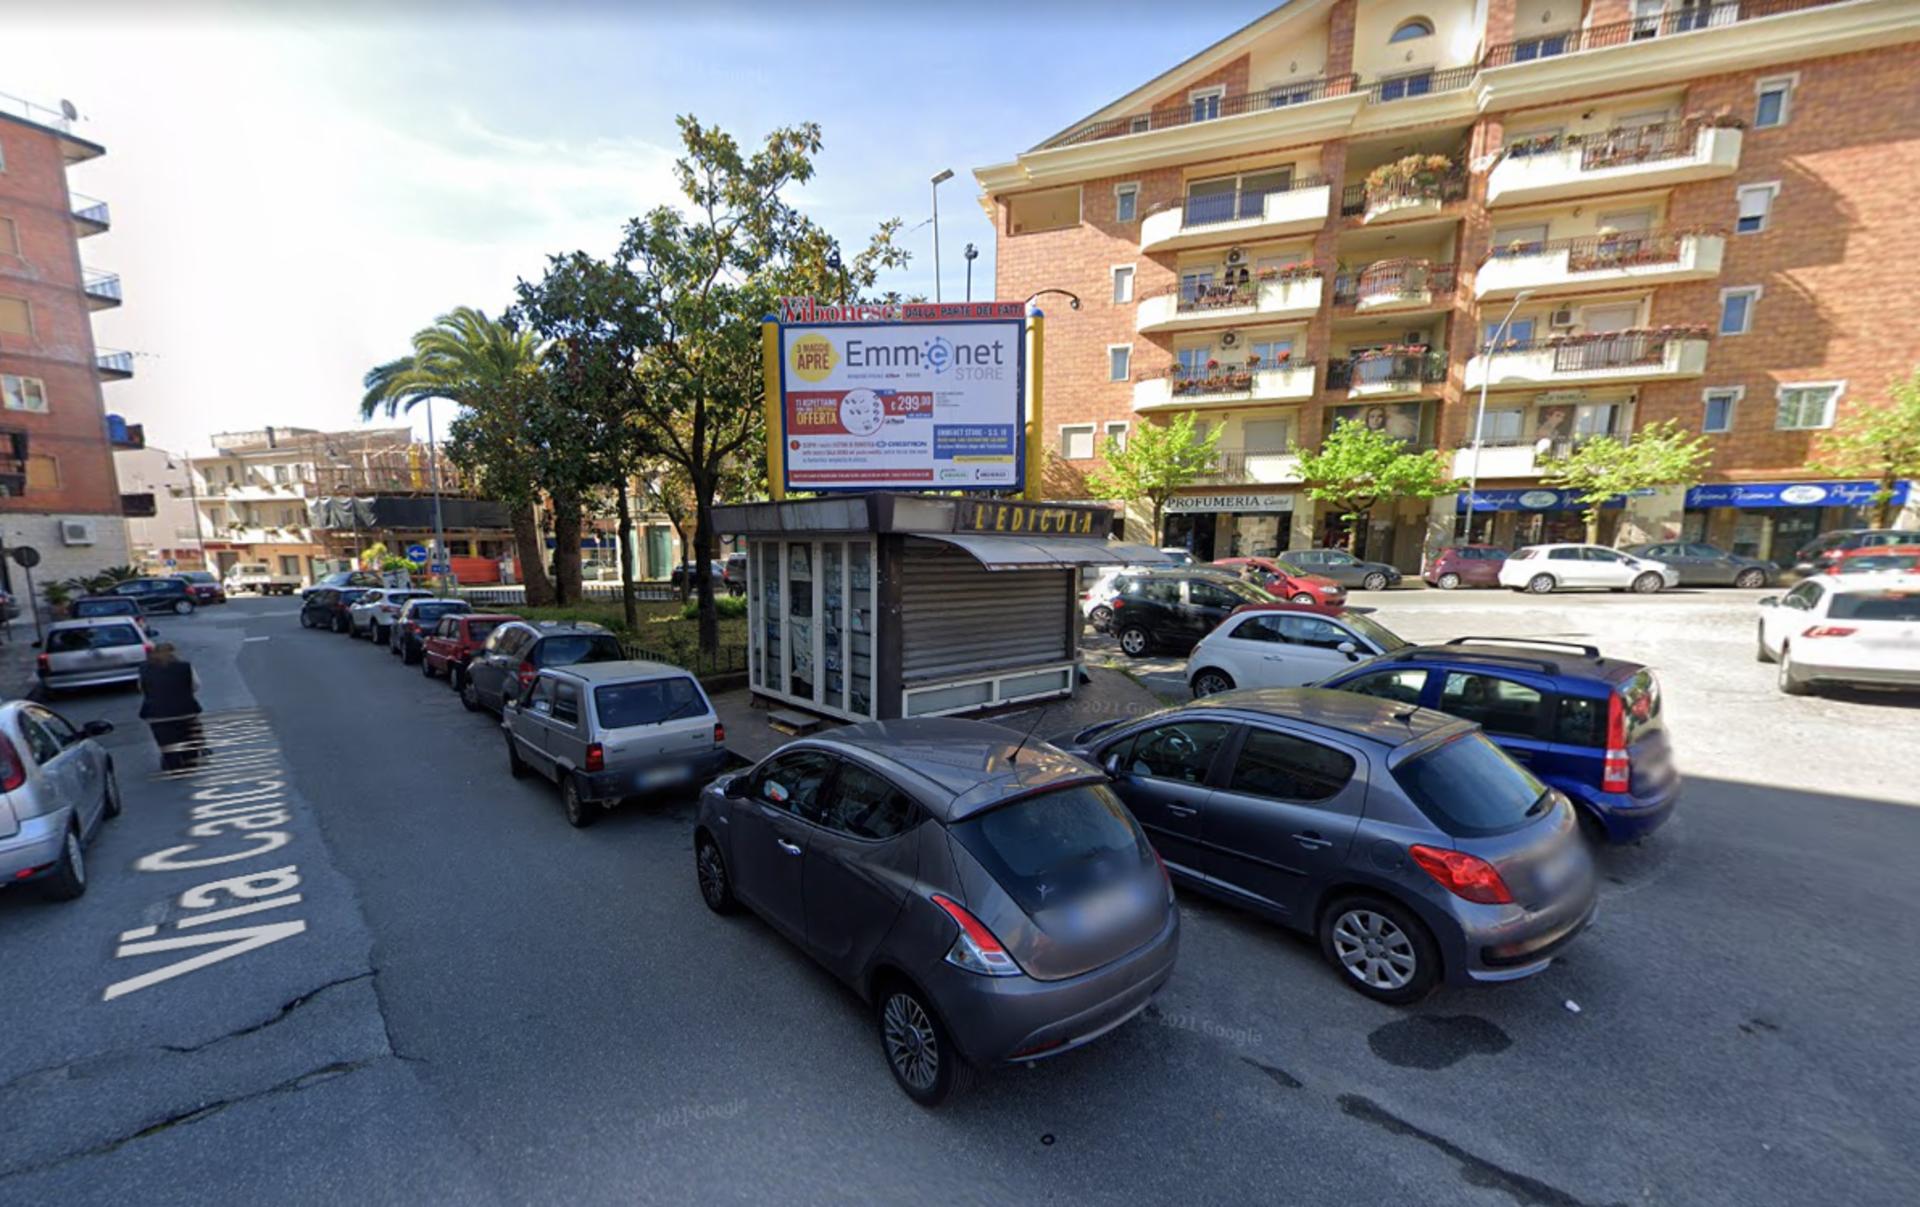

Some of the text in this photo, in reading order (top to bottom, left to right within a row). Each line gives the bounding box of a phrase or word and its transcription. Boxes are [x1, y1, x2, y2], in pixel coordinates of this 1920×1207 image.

[905, 307, 935, 318] DALLA
[940, 306, 970, 317] PARTE
[976, 306, 992, 316] DEI
[797, 354, 830, 371] APRE
[955, 368, 1003, 381] STORE
[796, 412, 837, 425] OFFERTA
[1166, 495, 1260, 509] PROFUMERIA
[975, 504, 1092, 533] L'EDICOLA
[103, 865, 307, 1002] Via
